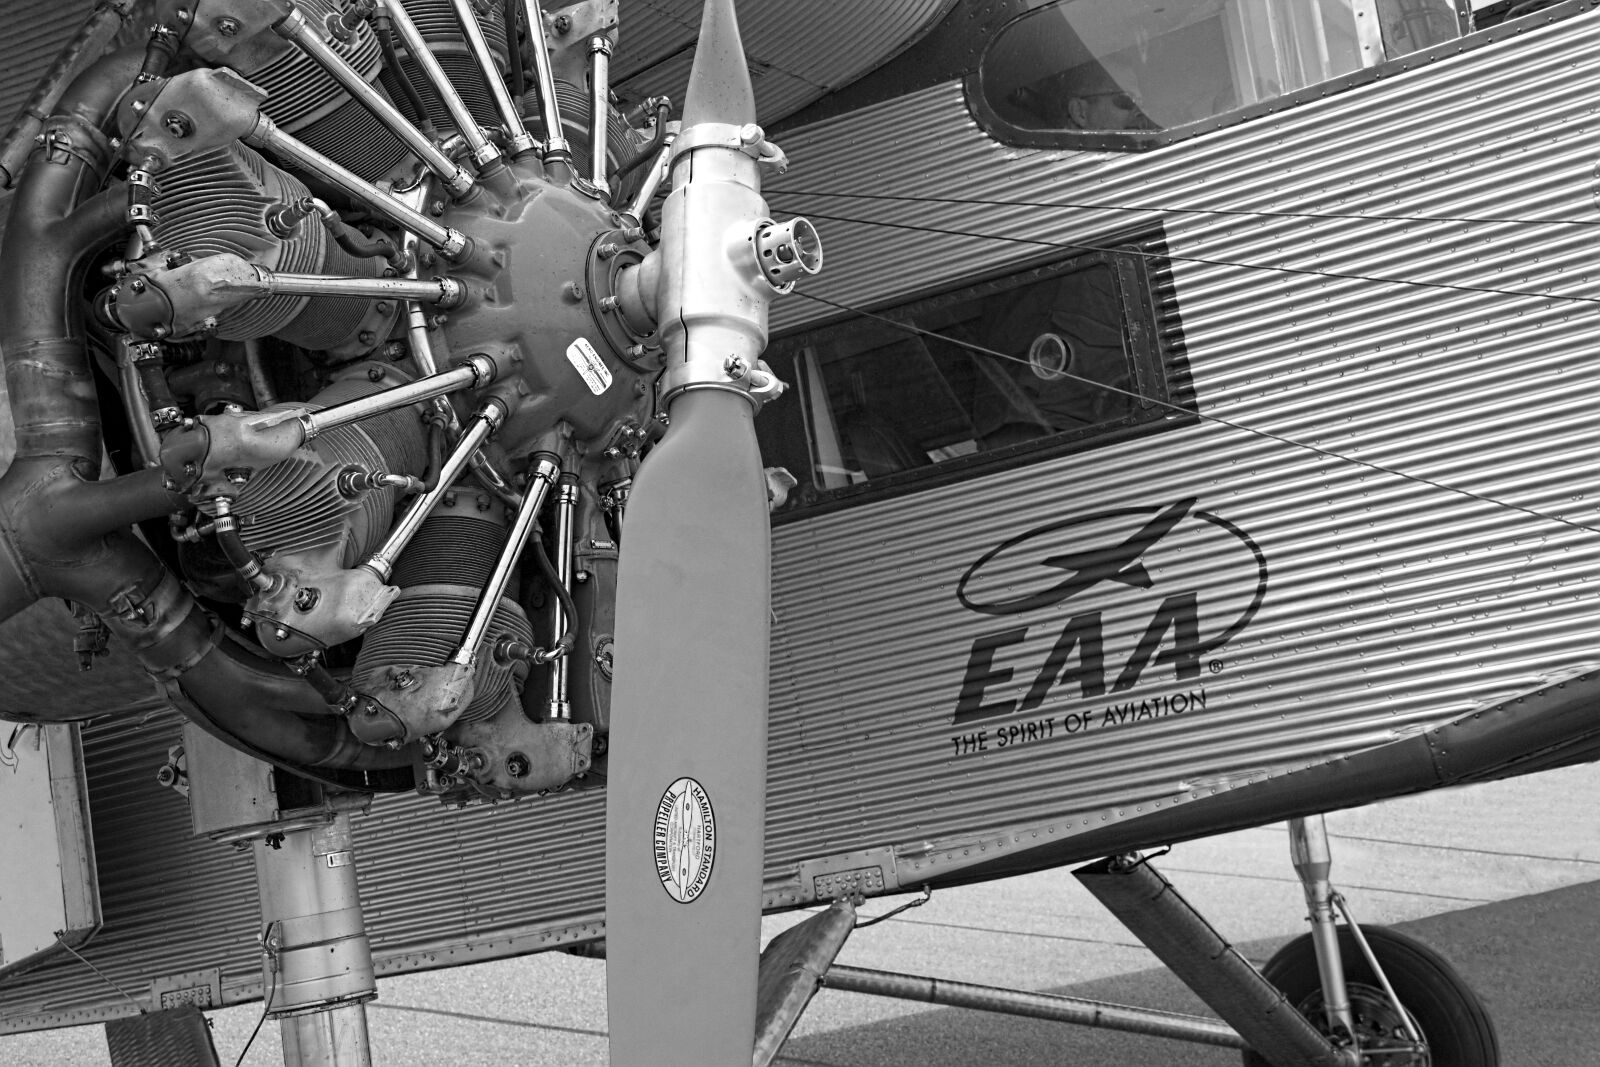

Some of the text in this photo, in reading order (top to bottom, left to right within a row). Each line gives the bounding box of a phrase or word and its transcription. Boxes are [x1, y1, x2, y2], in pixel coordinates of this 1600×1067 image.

[952, 592, 1201, 725] EAA
[952, 689, 1207, 756] THE SPIRIT OF AVIATION
[655, 790, 677, 883] PROPELLER COMPANY
[687, 787, 712, 898] HAMILTON STANDARD
